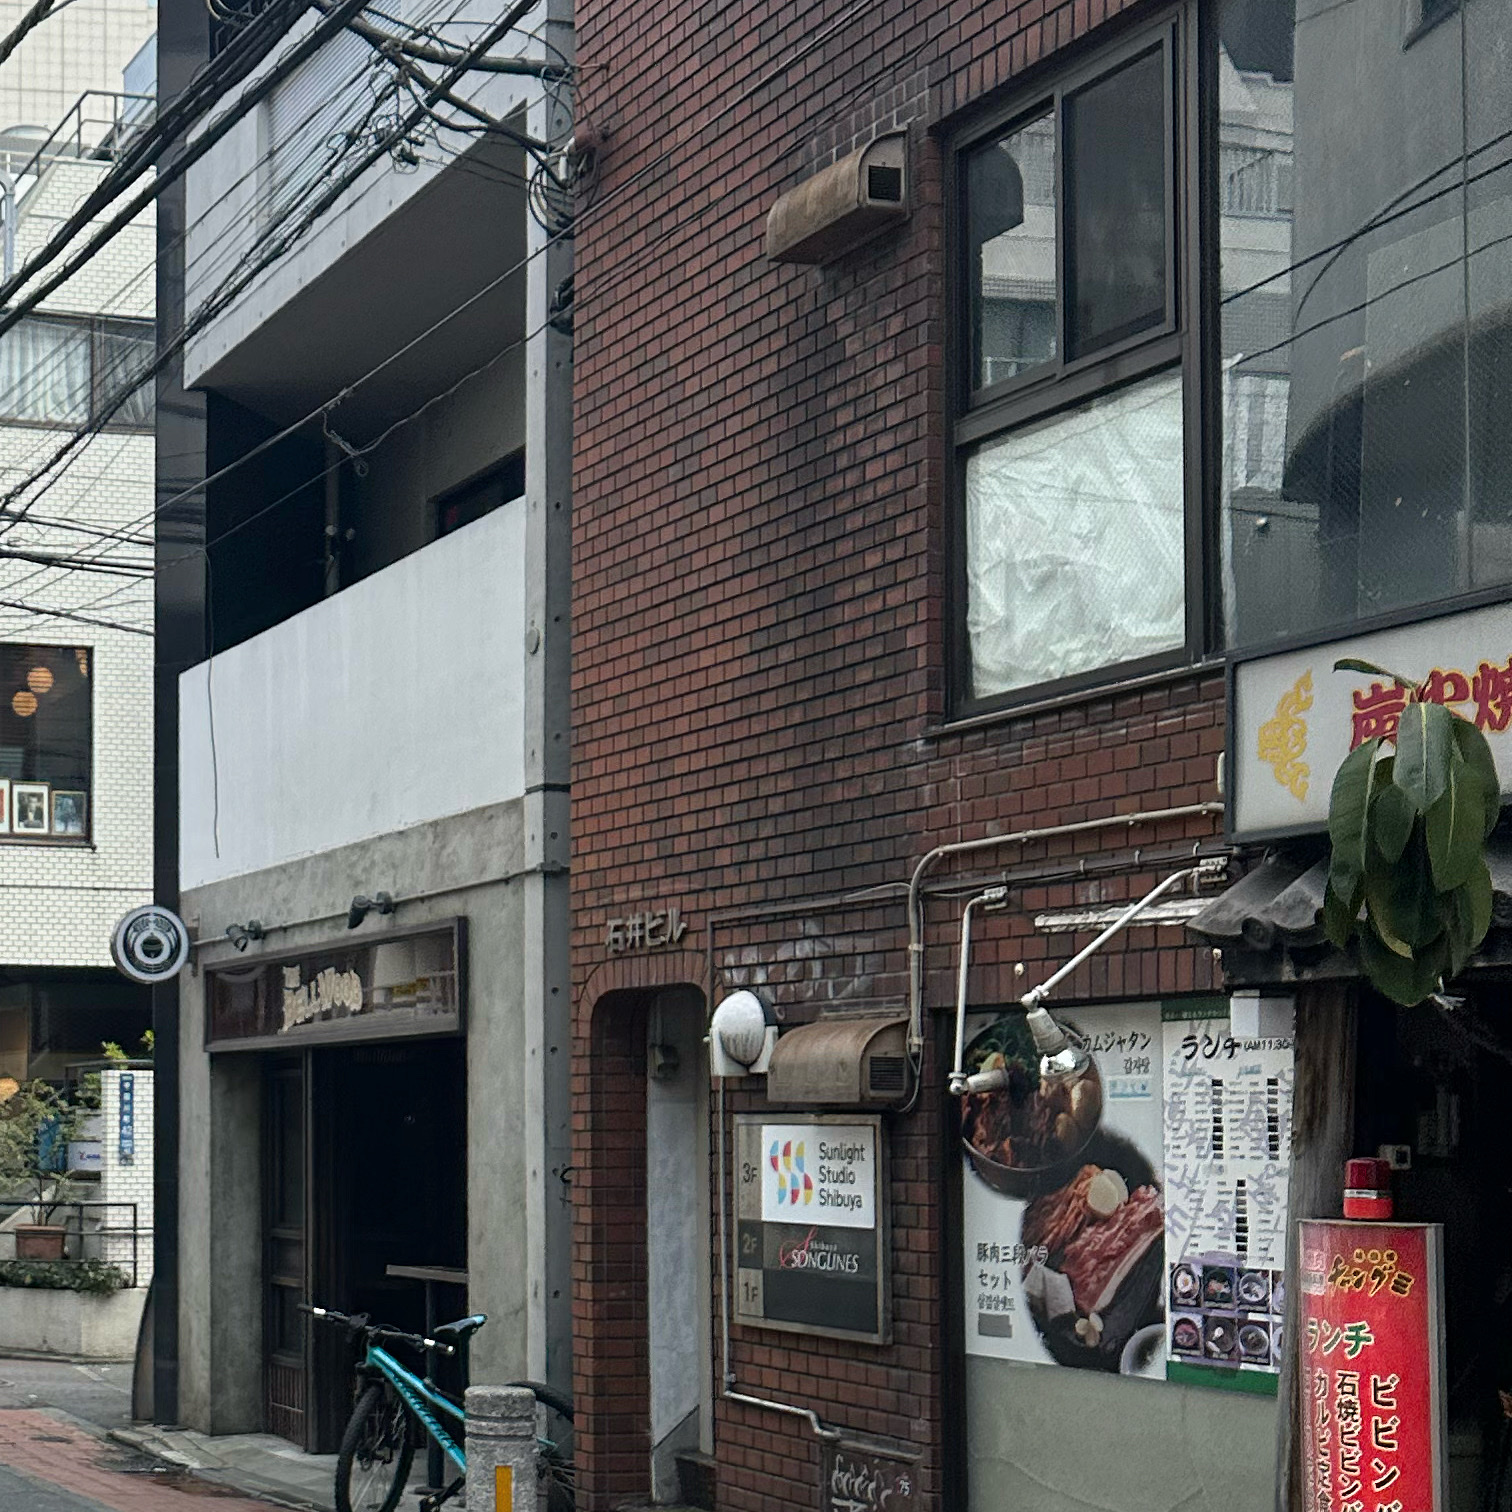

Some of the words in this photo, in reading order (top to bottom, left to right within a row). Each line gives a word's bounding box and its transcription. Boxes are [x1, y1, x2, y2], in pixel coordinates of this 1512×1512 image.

[605, 907, 687, 953] 石井ビル
[1182, 1034, 1241, 1061] ランチ
[819, 1142, 865, 1165] Sunlight
[743, 1163, 757, 1184] 3F
[819, 1165, 856, 1184] Studio
[819, 1188, 863, 1211] Shibuya
[742, 1234, 757, 1254] 2F
[978, 1269, 1012, 1290] セット
[744, 1282, 758, 1302] 1F
[1306, 1317, 1375, 1359] ランチ
